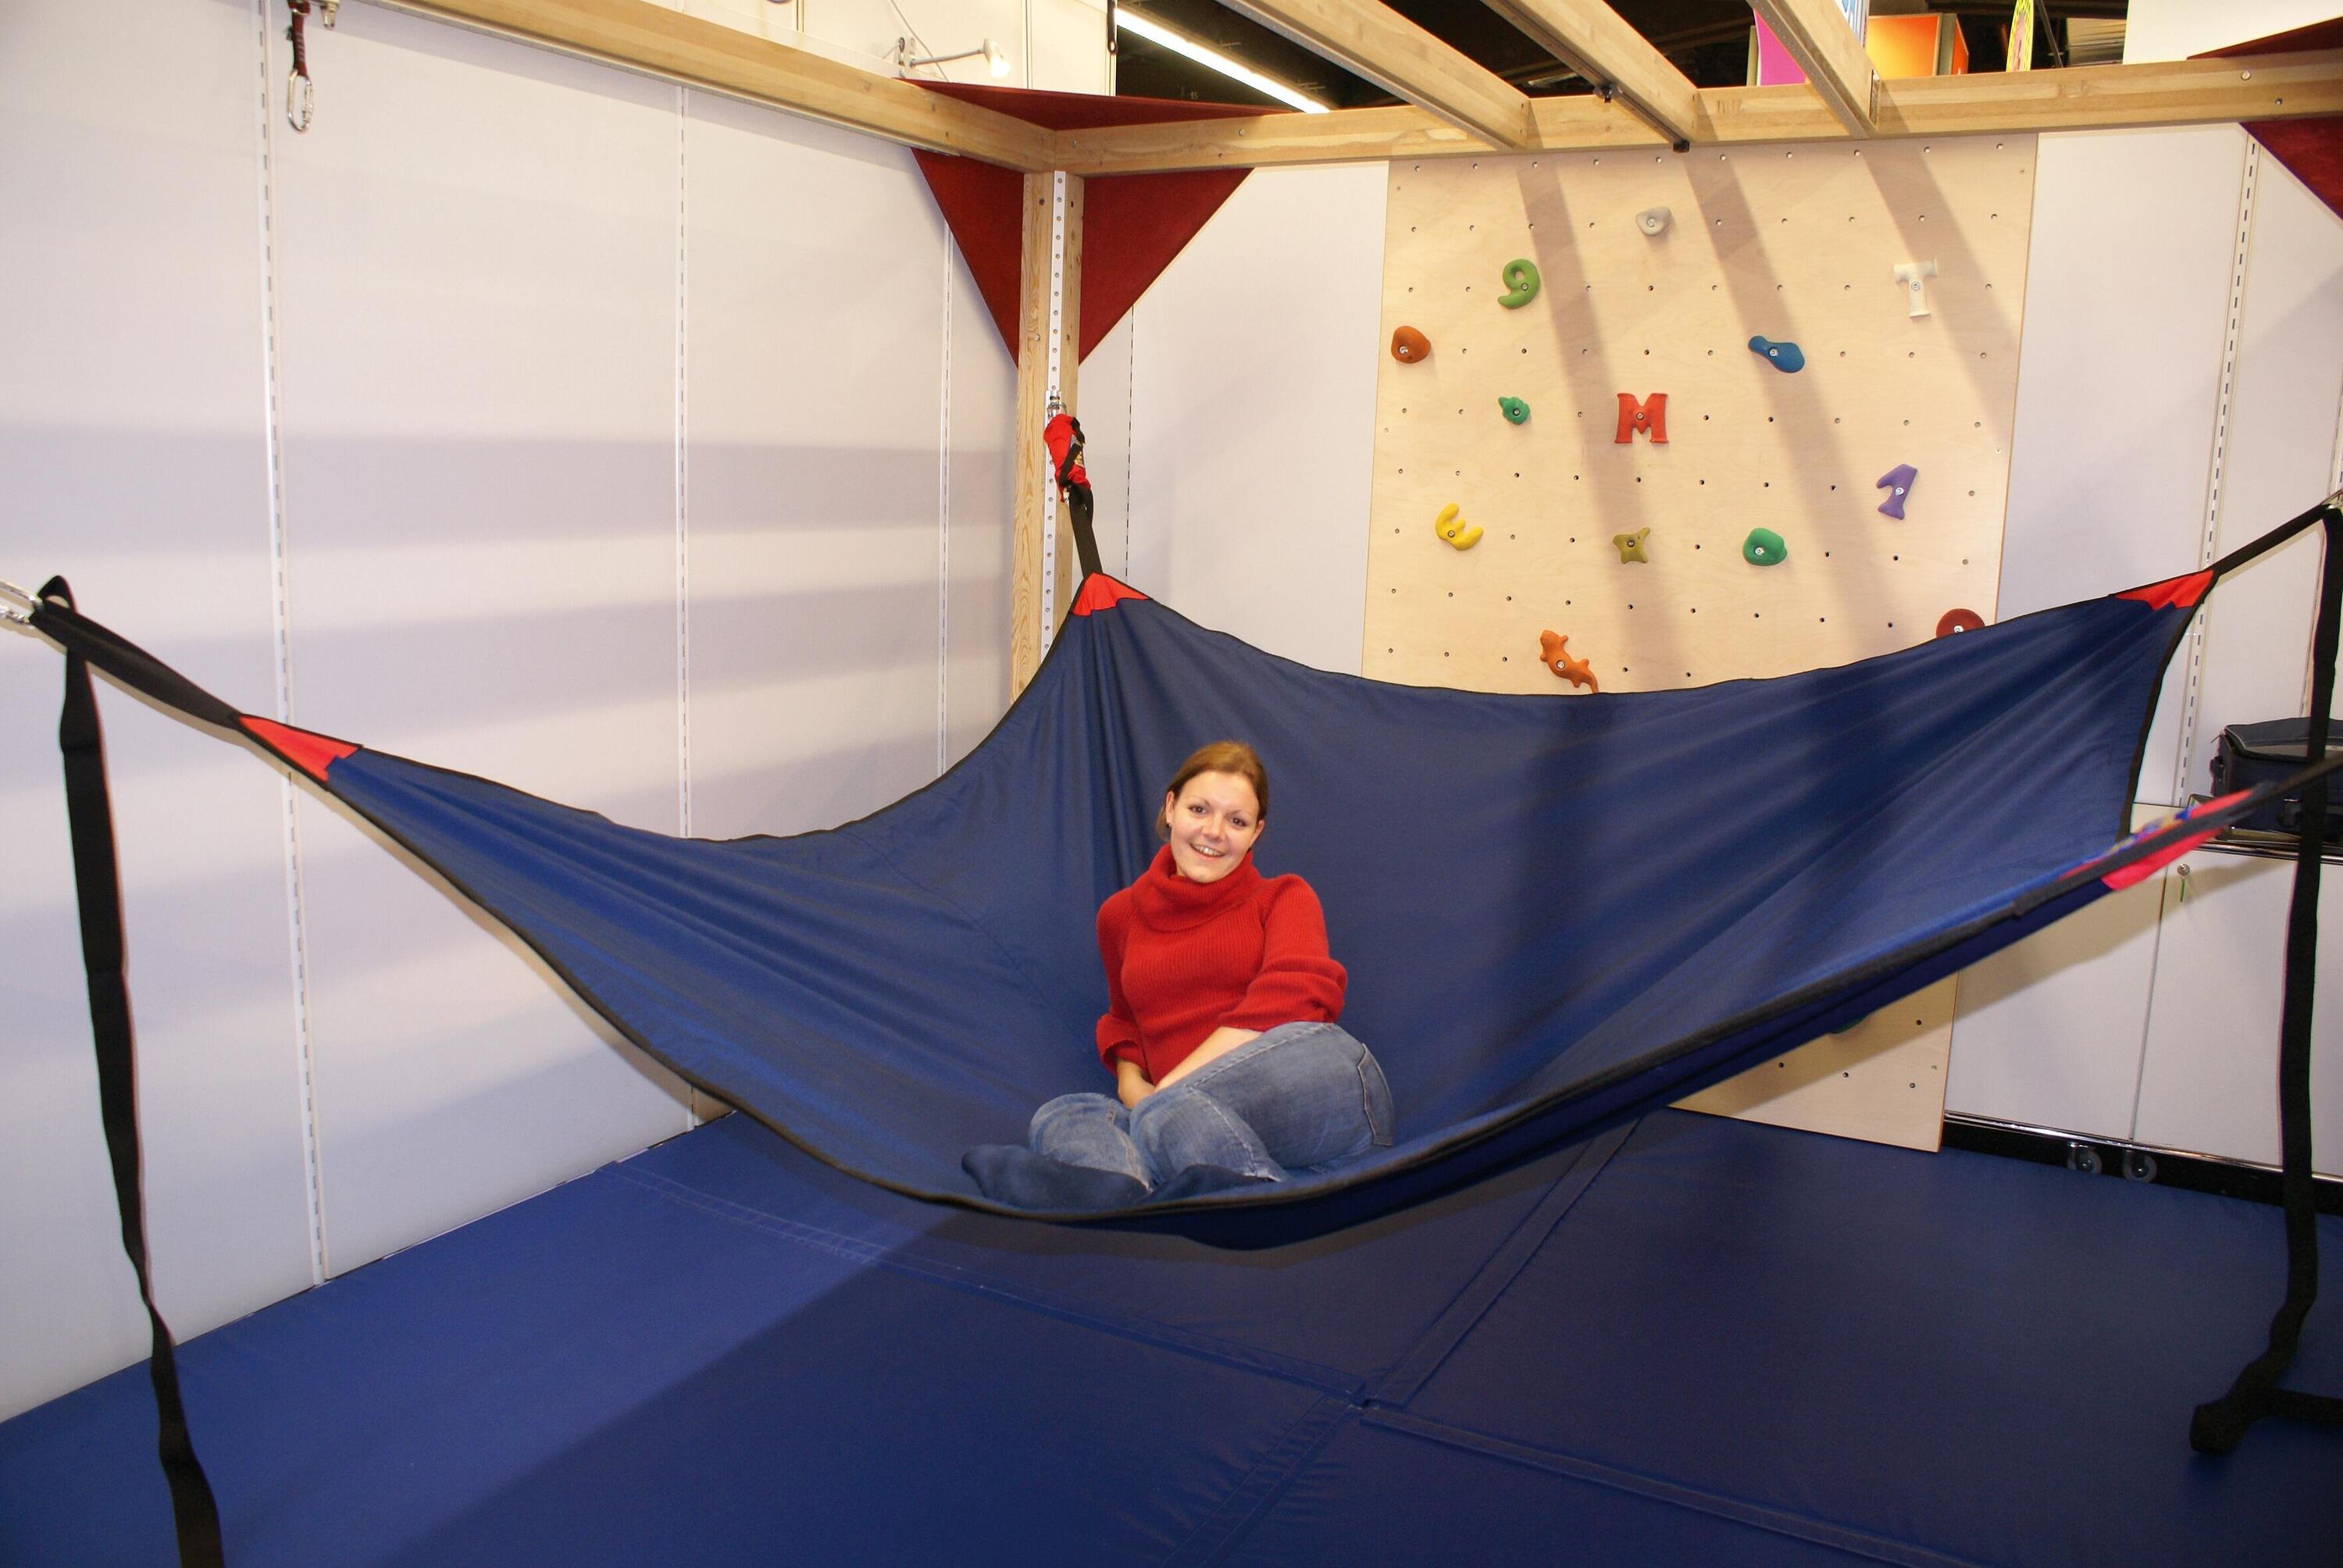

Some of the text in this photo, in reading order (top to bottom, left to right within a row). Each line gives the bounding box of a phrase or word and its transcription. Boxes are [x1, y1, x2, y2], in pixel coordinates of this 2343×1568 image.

[1497, 258, 1541, 309] 9
[1893, 258, 1938, 319] T
[1614, 393, 1669, 444] M
[1876, 463, 1918, 520] 1
